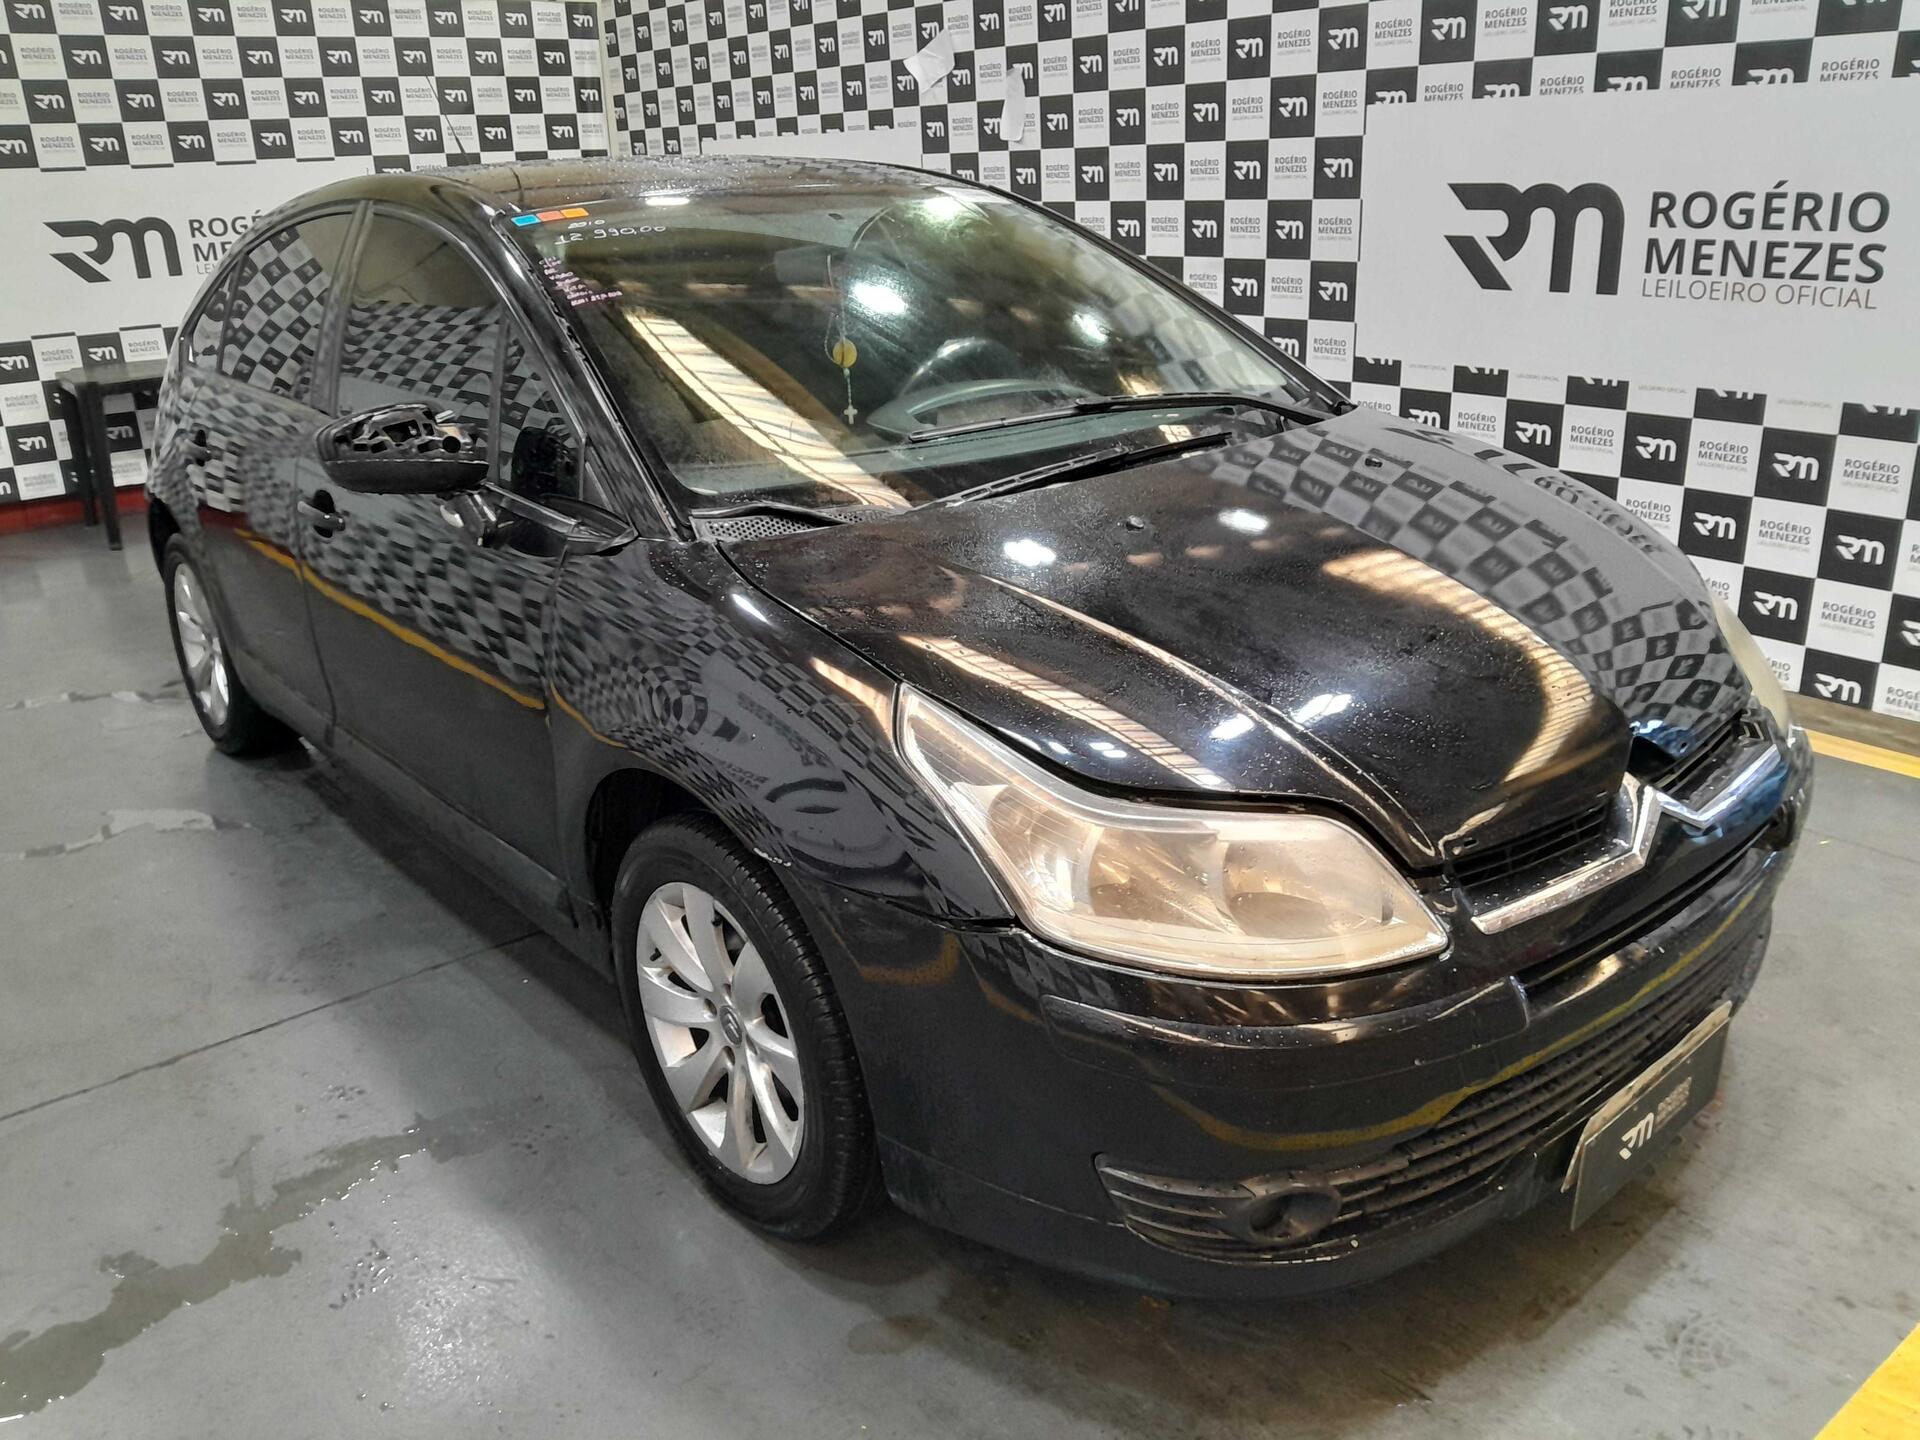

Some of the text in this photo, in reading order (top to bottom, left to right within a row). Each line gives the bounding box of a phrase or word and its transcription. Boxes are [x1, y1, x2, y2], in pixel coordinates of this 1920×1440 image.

[1485, 7, 1527, 19] ROGÉRIO
[1609, 6, 1657, 18] MENEZES
[1375, 18, 1412, 29] ROGÉRIO
[1485, 17, 1527, 29] MENEZES
[1278, 29, 1311, 39] ROGÉRIO
[1375, 28, 1412, 39] MENEZES
[1191, 38, 1220, 48] ROGÉRIO
[1278, 38, 1311, 48] MENEZES
[1114, 48, 1140, 56] ROGÉRIO
[1191, 47, 1221, 57] MENEZES
[1114, 56, 1140, 65] MENEZES
[1822, 58, 1880, 72] ROGÉRIO
[1671, 66, 1721, 79] ROGÉRIO
[1540, 75, 1584, 87] ROGÉRIO
[1425, 83, 1463, 93] ROGÉRIO
[1232, 96, 1263, 105] ROGÉRIO
[1323, 90, 1357, 100] ROGÉRIO
[1152, 102, 1179, 111] ROGÉRIO
[1323, 99, 1357, 108] MENEZES
[1152, 111, 1179, 119] MENEZES
[1232, 105, 1263, 114] MENEZES
[1115, 161, 1141, 169] ROGÉRIO
[1190, 159, 1219, 167] ROGÉRIO
[1275, 156, 1307, 164] ROGÉRIO
[1275, 165, 1307, 173] MENEZES
[1649, 180, 1890, 233] ROGÉRIO
[1152, 216, 1178, 224] ROGÉRIO
[1231, 217, 1260, 225] ROGÉRIO
[1319, 217, 1352, 226] ROGÉRIO
[1444, 182, 1624, 295] RM
[43, 217, 182, 282] RM
[1644, 238, 1888, 284] MENEZES
[1272, 276, 1303, 285] ROGÉRIO
[1272, 285, 1302, 293] MENEZES
[1642, 278, 1878, 310] LEILOEIRO OFICIAL
[1314, 338, 1346, 347] ROGÉRIO
[1314, 346, 1346, 355] MENEZES
[1458, 412, 1496, 423] ROGÉRIO
[1458, 421, 1496, 432] MENEZES
[1571, 425, 1614, 438] ROGÉRIO
[1570, 434, 1613, 447] MENEZES
[1700, 440, 1748, 454] ROGÉRIO
[1698, 450, 1747, 464] MENEZES
[1845, 459, 1900, 474] ROGÉRIO
[1843, 469, 1899, 484] MENEZES
[1626, 499, 1671, 513] ROGÉRIO
[1760, 520, 1811, 535] ROGÉRIO
[1759, 530, 1810, 545] MENEZES
[1823, 602, 1876, 619] ROGÉRIO
[1822, 612, 1875, 629] MENEZES
